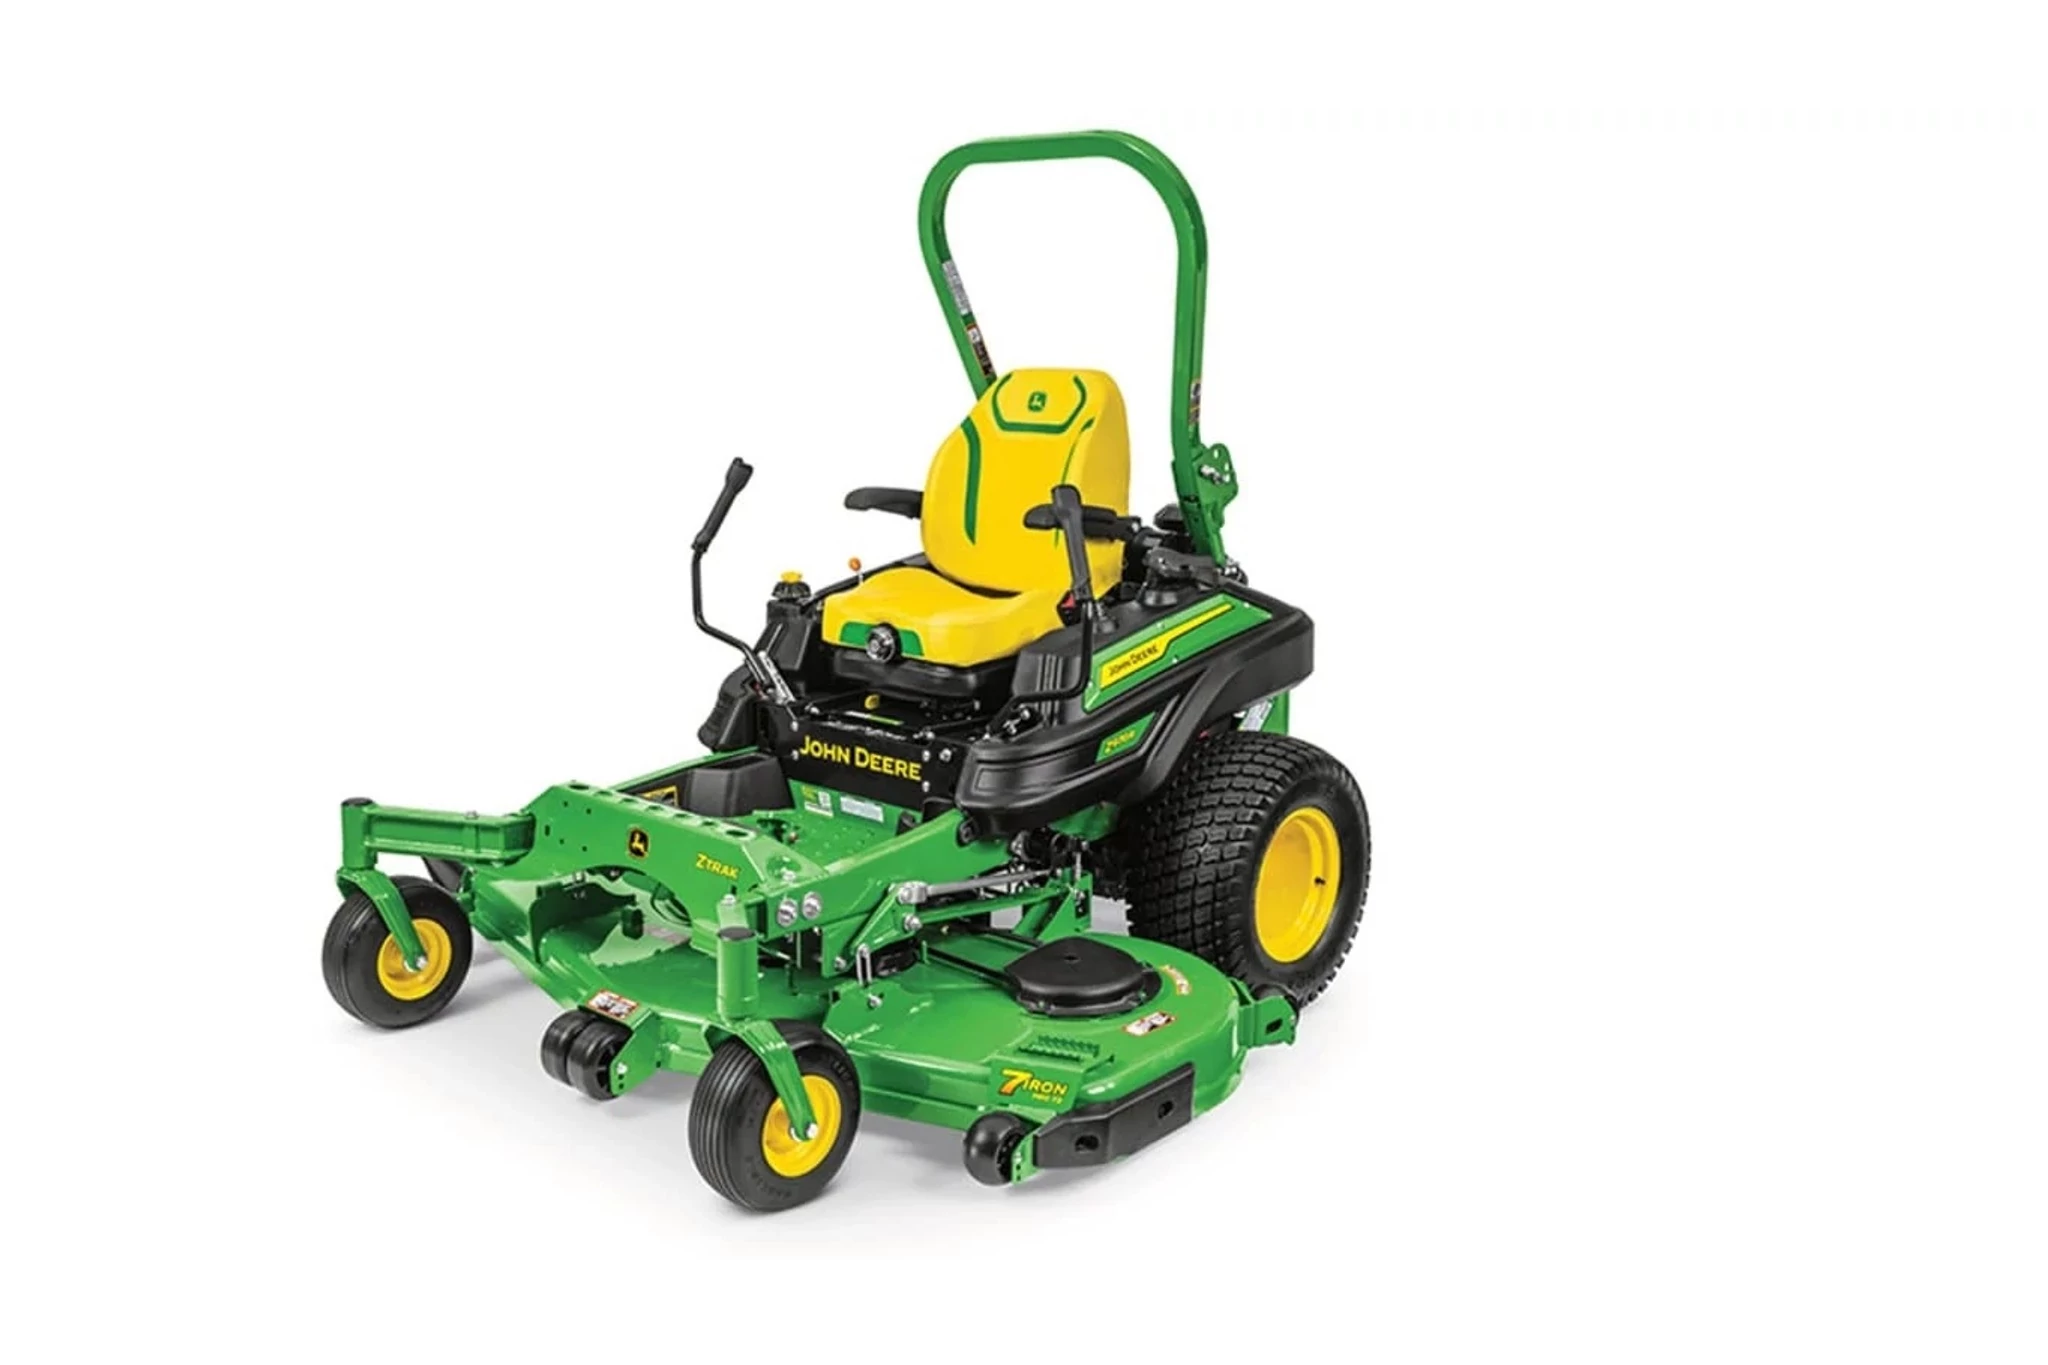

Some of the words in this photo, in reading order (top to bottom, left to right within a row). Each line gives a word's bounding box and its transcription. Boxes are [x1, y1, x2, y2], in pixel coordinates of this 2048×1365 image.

[800, 735, 850, 765] JOHN
[854, 746, 922, 781] DEERE
[695, 853, 738, 879] ZTRAK
